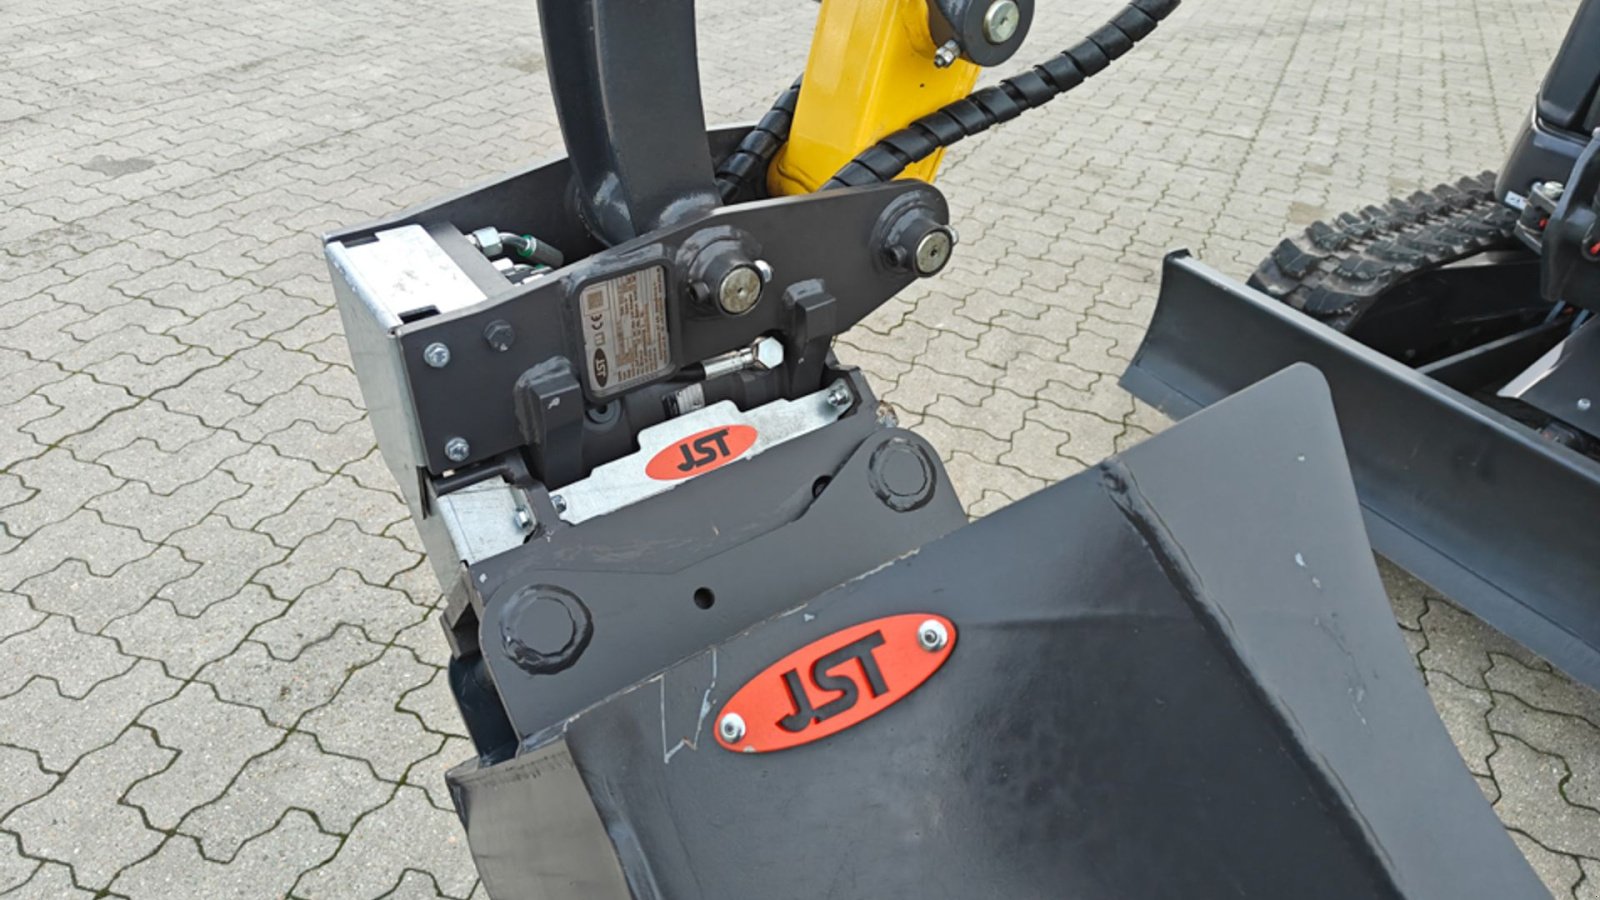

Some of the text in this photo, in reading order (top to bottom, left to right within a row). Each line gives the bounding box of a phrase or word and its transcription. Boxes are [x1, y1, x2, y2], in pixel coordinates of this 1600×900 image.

[596, 358, 606, 377] JST
[677, 429, 731, 472] JST
[775, 629, 890, 733] JST
